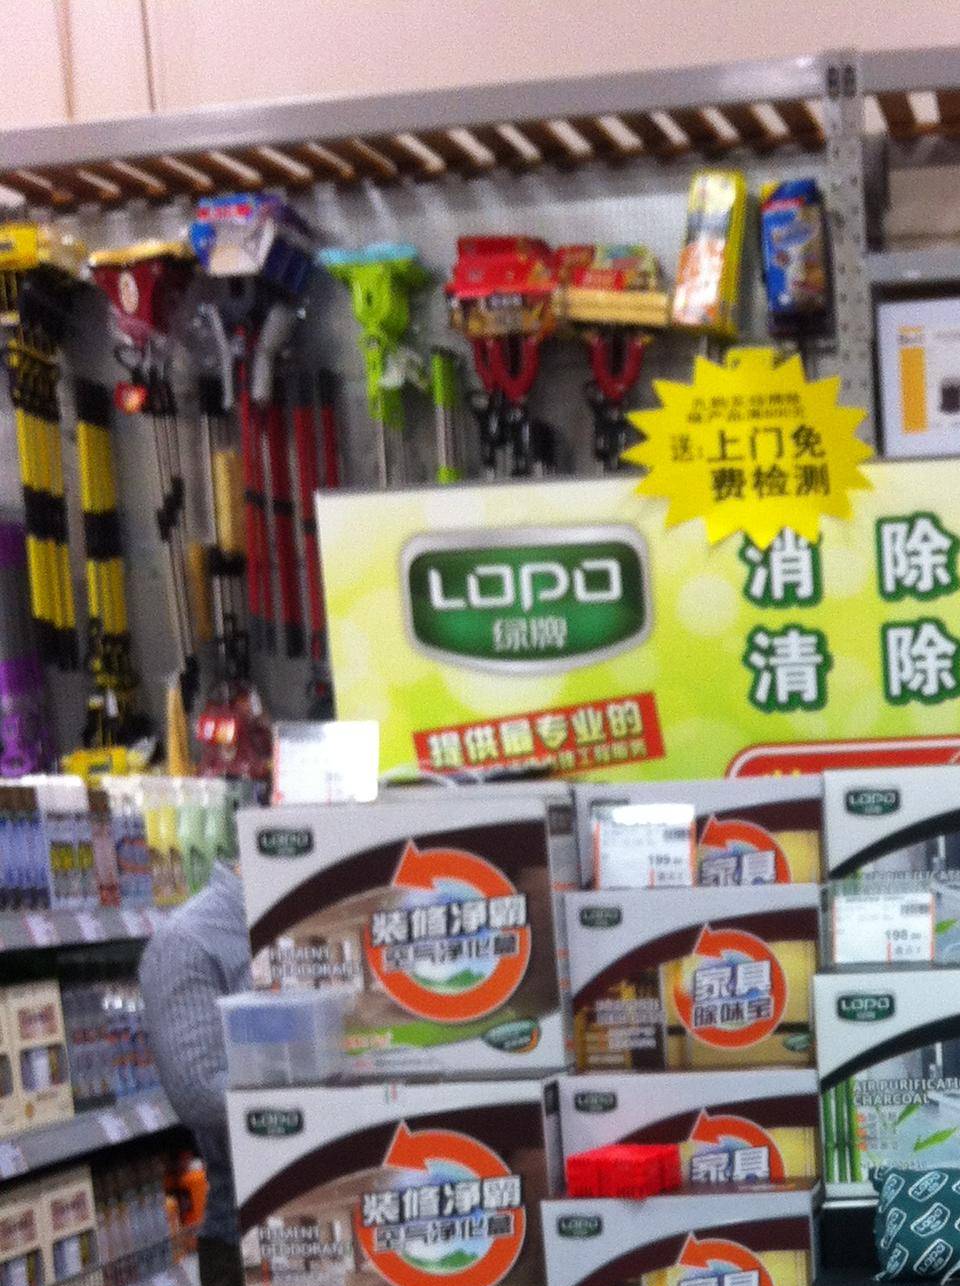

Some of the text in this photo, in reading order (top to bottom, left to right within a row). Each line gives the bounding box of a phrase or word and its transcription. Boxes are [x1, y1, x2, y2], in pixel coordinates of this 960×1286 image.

[712, 464, 830, 501] 费检测
[426, 558, 623, 611] LOPO
[428, 700, 644, 769] 提供最专业的
[695, 960, 772, 1000] 家具
